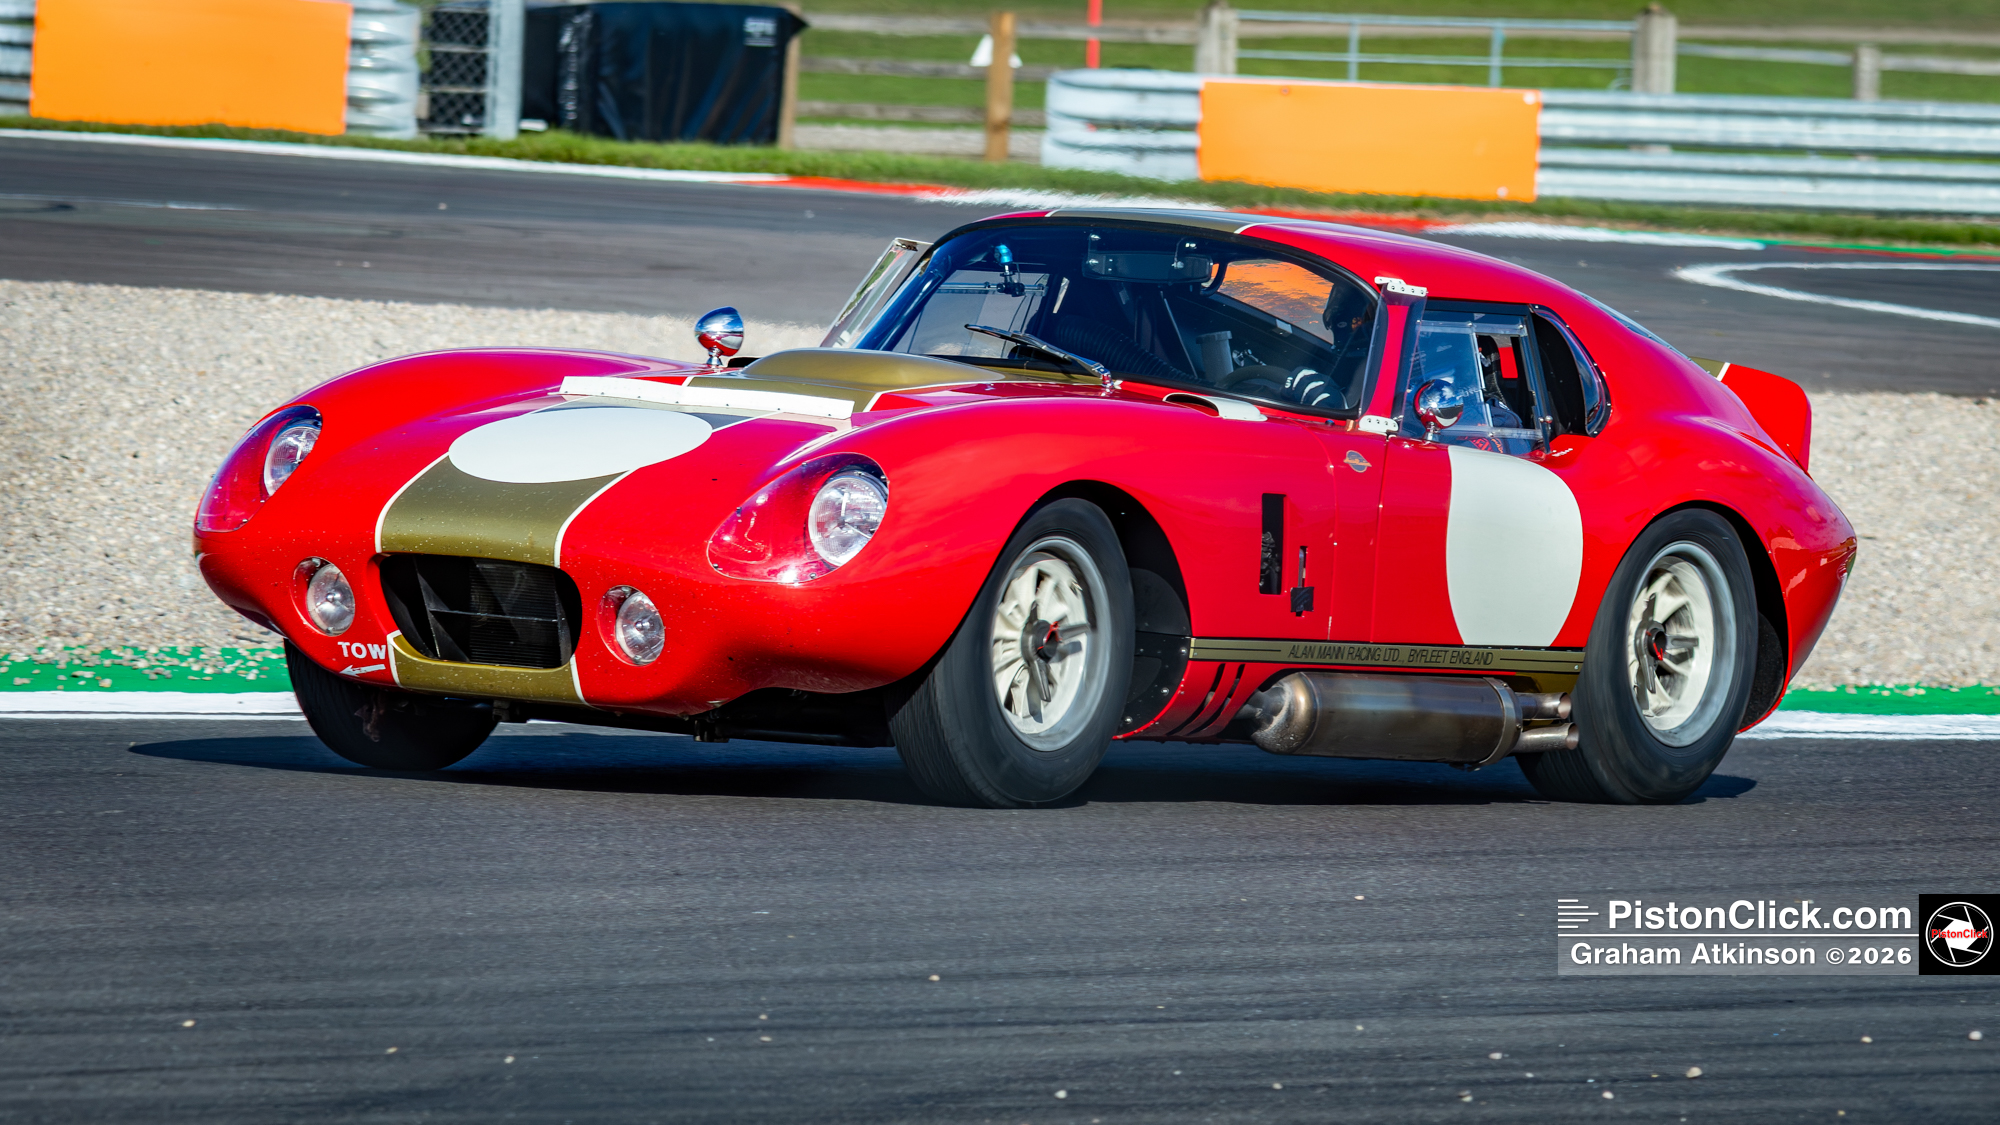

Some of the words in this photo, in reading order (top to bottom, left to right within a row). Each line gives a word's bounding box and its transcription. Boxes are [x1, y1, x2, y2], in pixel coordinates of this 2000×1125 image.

[337, 641, 386, 660] TOW
[1288, 644, 1316, 659] ALAN
[1316, 645, 1345, 660] MANN
[1346, 646, 1381, 661] RACING
[1407, 648, 1450, 664] BYFLEET
[1449, 650, 1494, 665] ENGLAND
